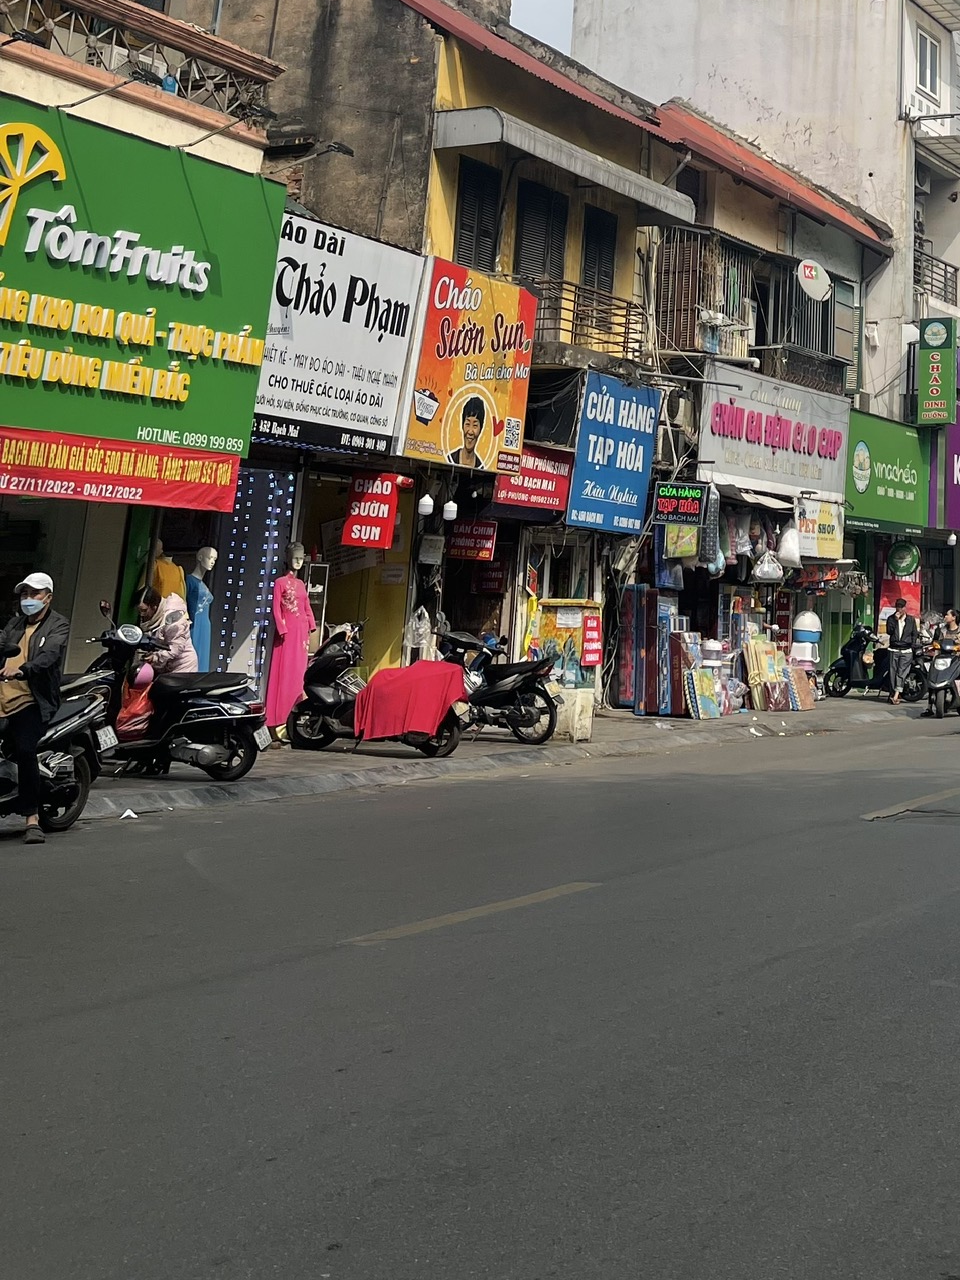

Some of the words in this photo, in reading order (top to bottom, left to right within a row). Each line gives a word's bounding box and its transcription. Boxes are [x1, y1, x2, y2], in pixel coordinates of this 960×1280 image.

[280, 216, 307, 244] Áo
[313, 228, 346, 256] Dài
[275, 256, 337, 318] Thảo
[342, 275, 411, 342] Phạm
[433, 276, 483, 311] Cháo
[27, 293, 74, 331] KHO
[71, 302, 114, 338] HOA
[115, 308, 157, 347] QUẢ
[167, 322, 214, 360] THỰC
[212, 325, 264, 366] PHẨM
[436, 315, 486, 360] Sườn
[490, 312, 526, 360] Sụn
[263, 343, 278, 363] HIẾT
[0, 339, 45, 380] TIÊU
[41, 346, 102, 388] DÙNG
[100, 356, 154, 396] MIỀN
[150, 361, 190, 402] BẮC
[464, 362, 478, 381] Bà
[479, 362, 495, 380] Lai
[496, 364, 514, 383] chợ
[929, 352, 942, 397] CHÁO
[268, 374, 289, 390] CHO
[290, 377, 316, 395] THUÊ
[315, 381, 332, 398] CÁC
[334, 387, 354, 406] LOẠI
[355, 389, 367, 405] ÁO
[369, 392, 384, 408] DÀI
[923, 400, 947, 409] DINH
[586, 385, 614, 424] CỬA
[618, 396, 656, 434] HÀNG
[137, 426, 181, 444] HOTLINE:
[183, 432, 207, 447] 0899
[209, 436, 224, 449] 199
[226, 437, 243, 451] 859
[711, 397, 746, 441] CHĂN
[745, 410, 763, 445] GA
[764, 408, 793, 456] ĐỆM
[792, 422, 817, 456] CAO
[1, 439, 29, 470] BẠCH
[28, 441, 48, 467] MAI
[49, 439, 70, 470] BÁN
[86, 440, 105, 472] GỐC
[104, 450, 121, 474] 500
[121, 448, 136, 476] MÃ
[161, 452, 183, 484] TẶNG
[201, 461, 217, 484] SET
[587, 433, 615, 470] TẠP
[616, 435, 644, 473] HÓA
[10, 476, 75, 495] 27/11/2022
[83, 483, 143, 500] 04/12/2022
[355, 477, 392, 496] CHÁO
[659, 484, 678, 497] CỬA
[678, 486, 701, 498] HÀNG
[350, 500, 389, 518] SƯỜN
[657, 498, 678, 513] TẠP
[678, 497, 700, 514] HÓA
[350, 524, 382, 543] SỤN
[472, 525, 494, 536] CHIM
[798, 518, 817, 534] PET
[817, 523, 836, 535] SHOP
